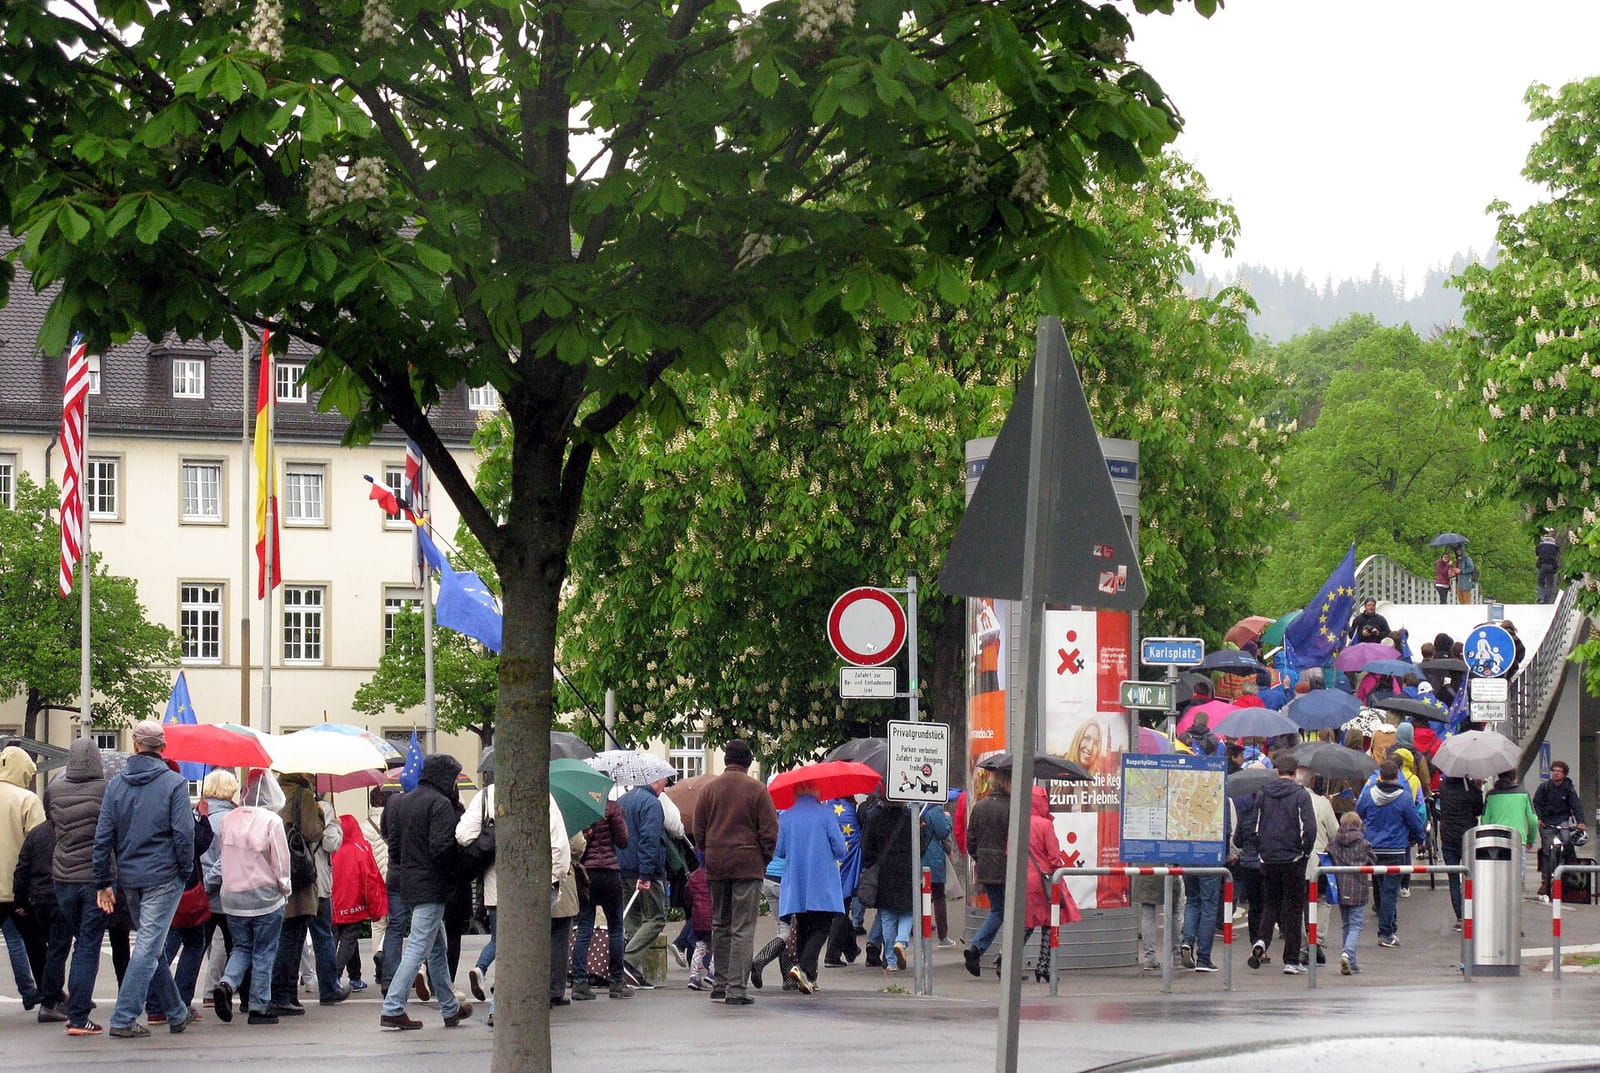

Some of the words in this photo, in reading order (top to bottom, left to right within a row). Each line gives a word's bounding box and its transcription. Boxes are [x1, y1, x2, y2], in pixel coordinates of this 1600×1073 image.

[1149, 647, 1196, 661] Karlsplatz
[1138, 687, 1152, 704] WC
[892, 726, 945, 741] Privatgrundstück
[900, 745, 917, 753] Parken
[895, 754, 913, 762] Zufahrt
[923, 755, 943, 766] Reinigung
[1091, 773, 1105, 786] die
[1106, 773, 1121, 790] Reg
[1049, 794, 1078, 805] zum
[1081, 790, 1120, 805] Erlebnis.
[340, 908, 349, 916] FC
